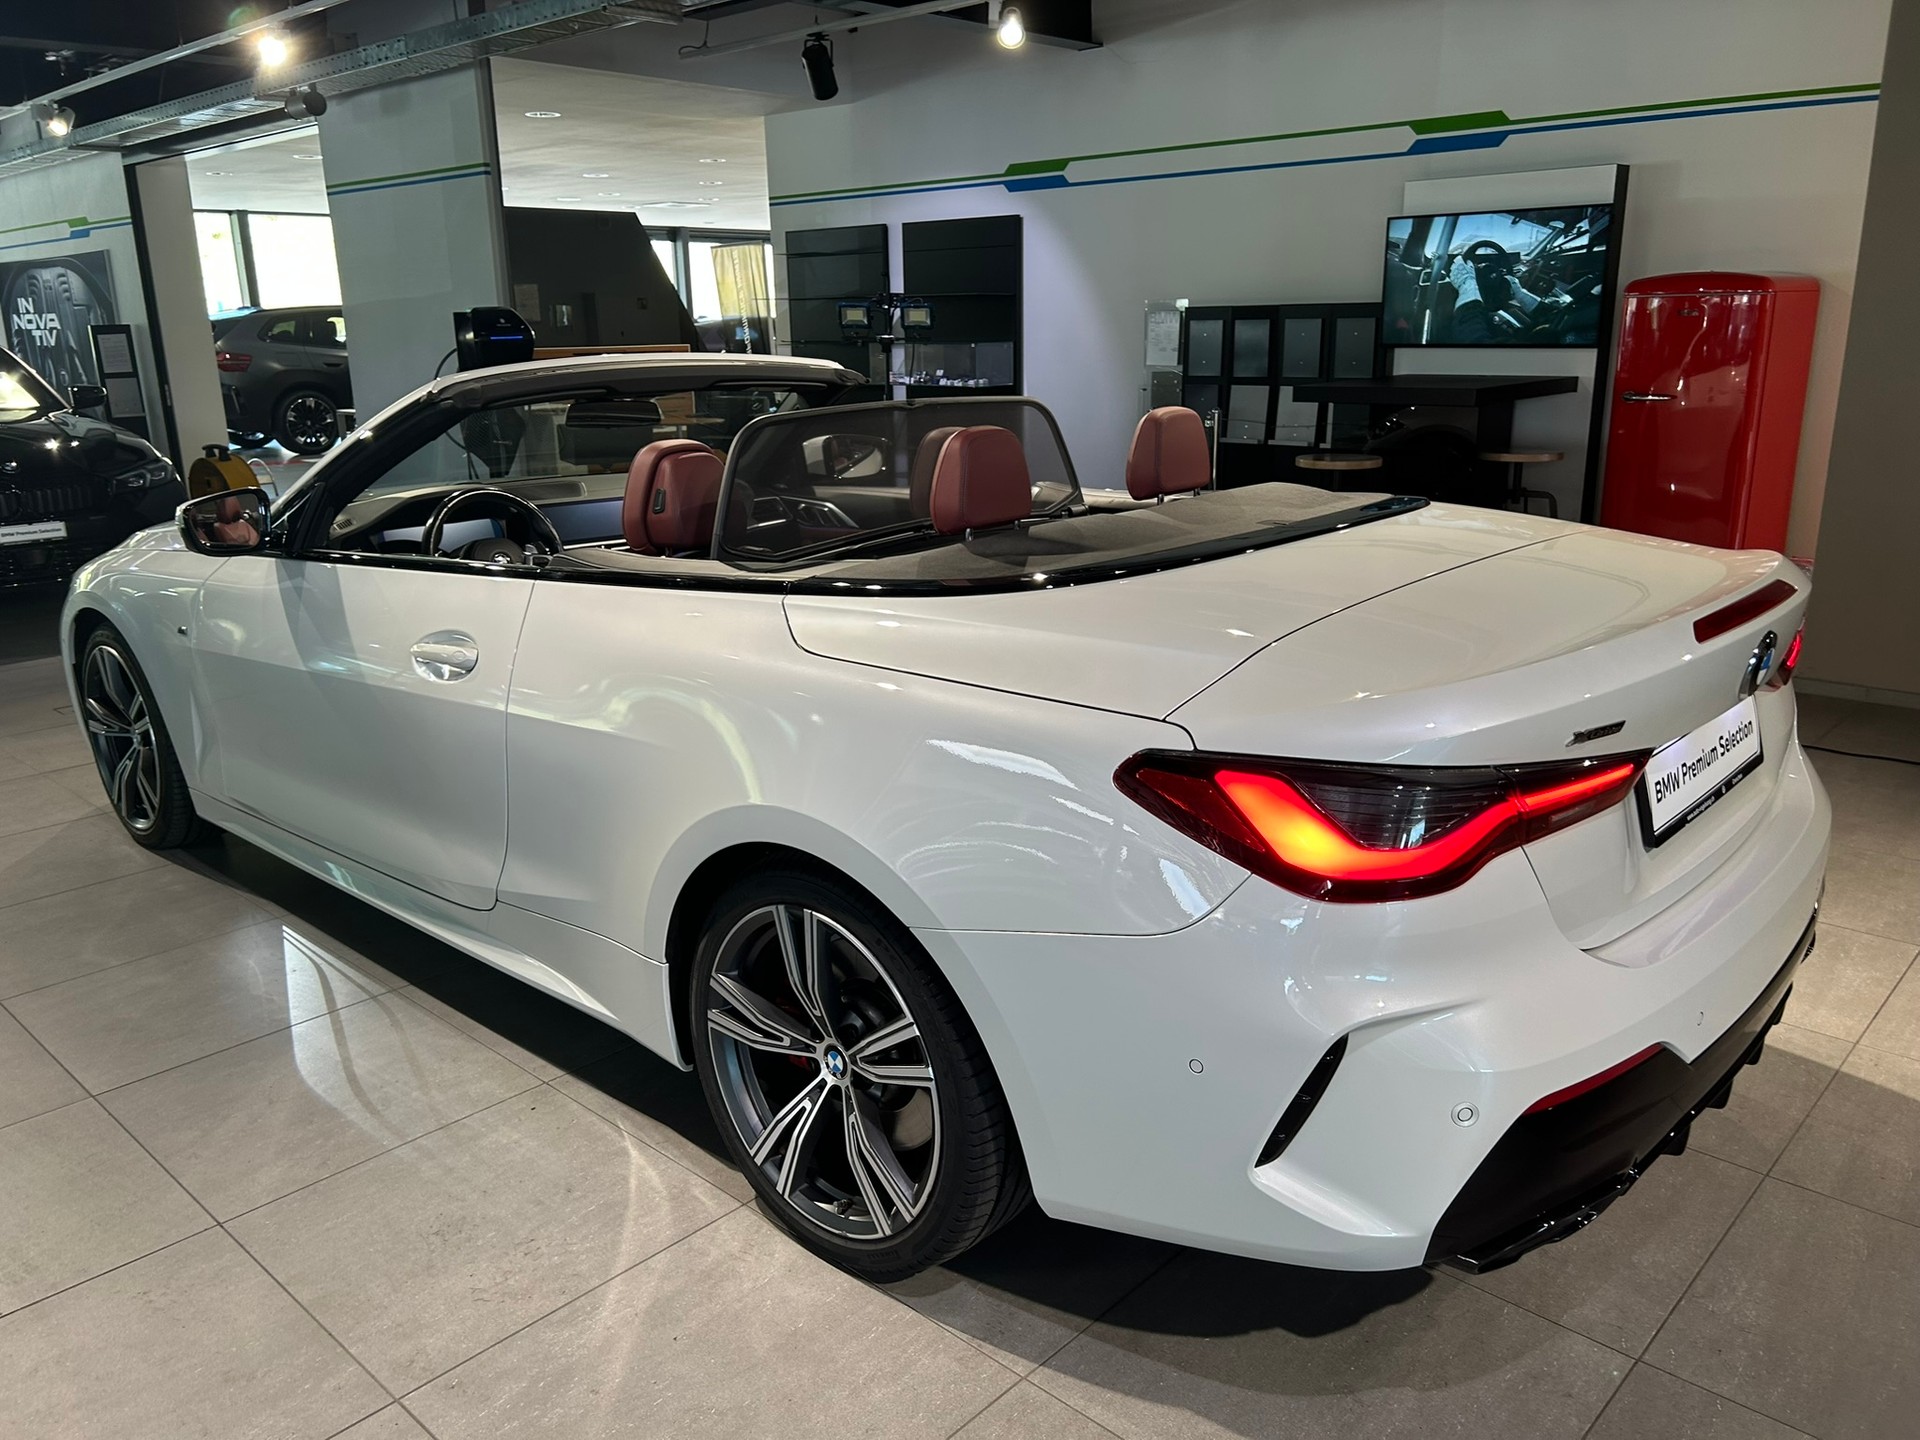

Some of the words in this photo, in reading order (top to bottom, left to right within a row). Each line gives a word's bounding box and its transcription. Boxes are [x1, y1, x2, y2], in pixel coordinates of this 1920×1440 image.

[17, 298, 34, 313] IN
[12, 314, 62, 330] NOVA
[31, 330, 57, 346] TIV
[1654, 771, 1680, 804] BMW
[1681, 745, 1718, 785] Premium
[1719, 720, 1754, 757] Selection
